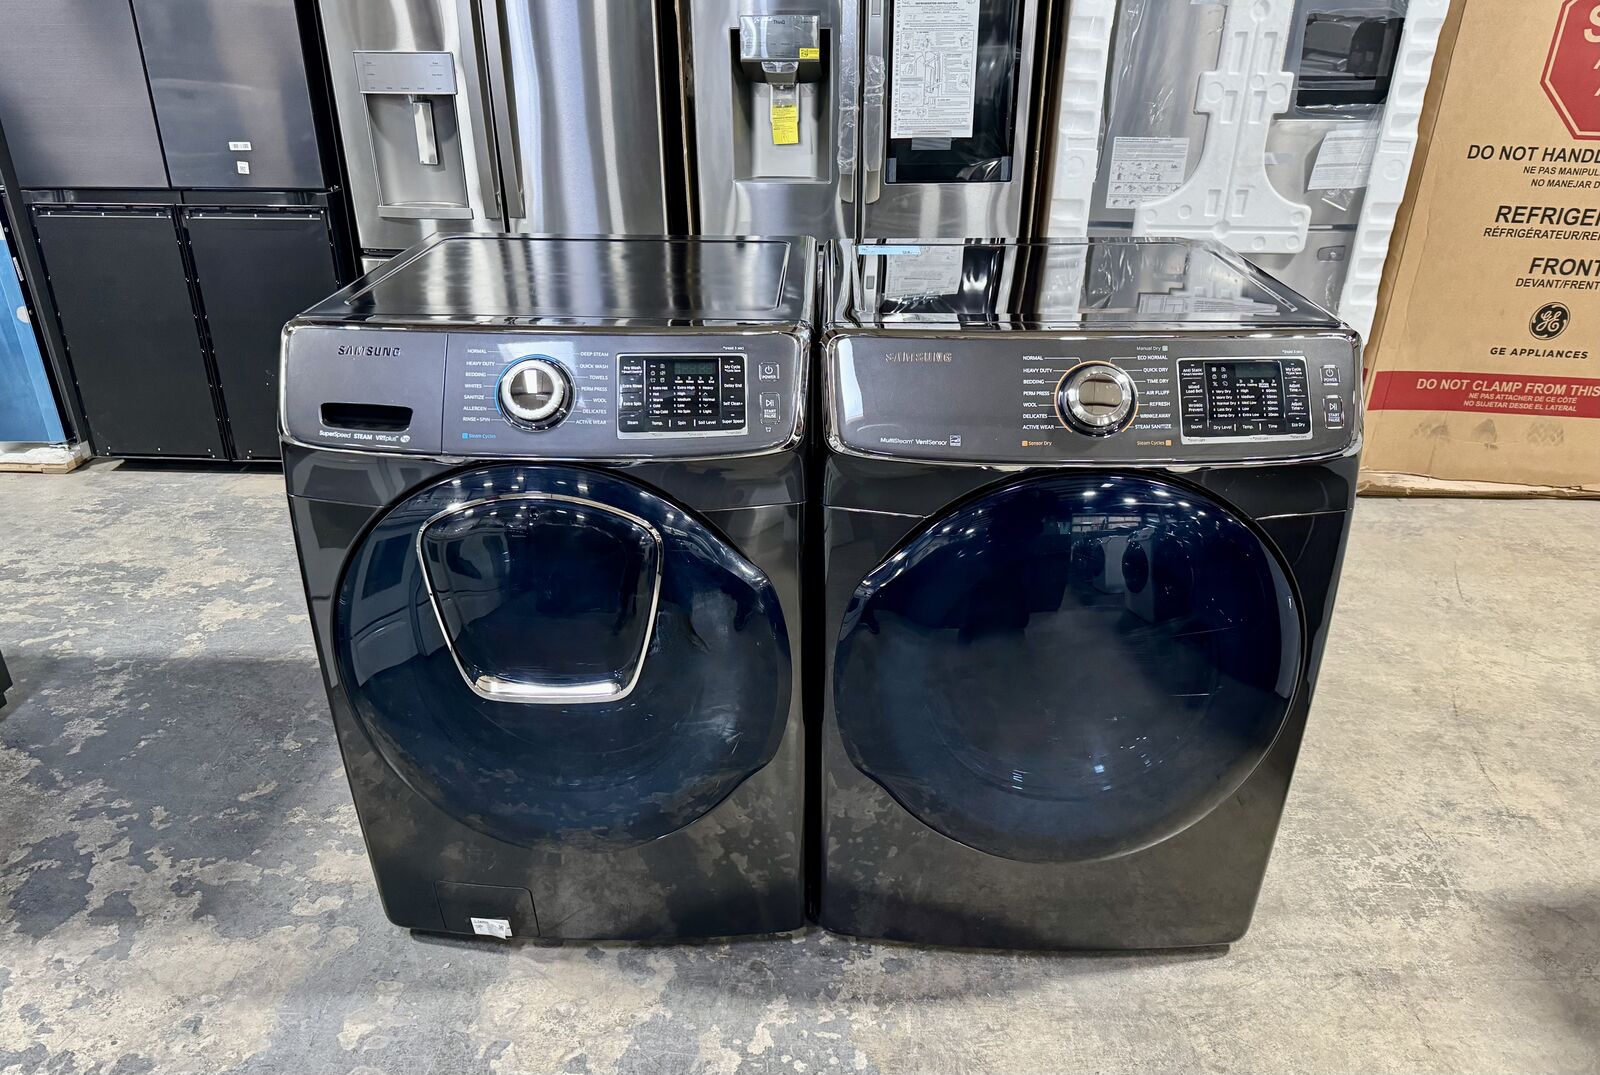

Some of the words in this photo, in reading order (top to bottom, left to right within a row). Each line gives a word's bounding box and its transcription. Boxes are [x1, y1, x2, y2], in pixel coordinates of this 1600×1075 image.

[1467, 145, 1494, 159] DO
[1499, 146, 1539, 161] NOT
[1538, 166, 1556, 174] PAS
[1547, 179, 1592, 188] MANEJAR
[338, 346, 400, 356] SAMSUNG
[1490, 347, 1506, 355] GE
[1510, 348, 1589, 359] APPLIANCES
[885, 352, 952, 363] SAMSUNG
[1416, 378, 1437, 390] DO
[1440, 379, 1470, 390] NOT
[1472, 380, 1522, 393] CLAMP
[1525, 383, 1567, 395] FROM
[1570, 384, 1600, 397] THIS
